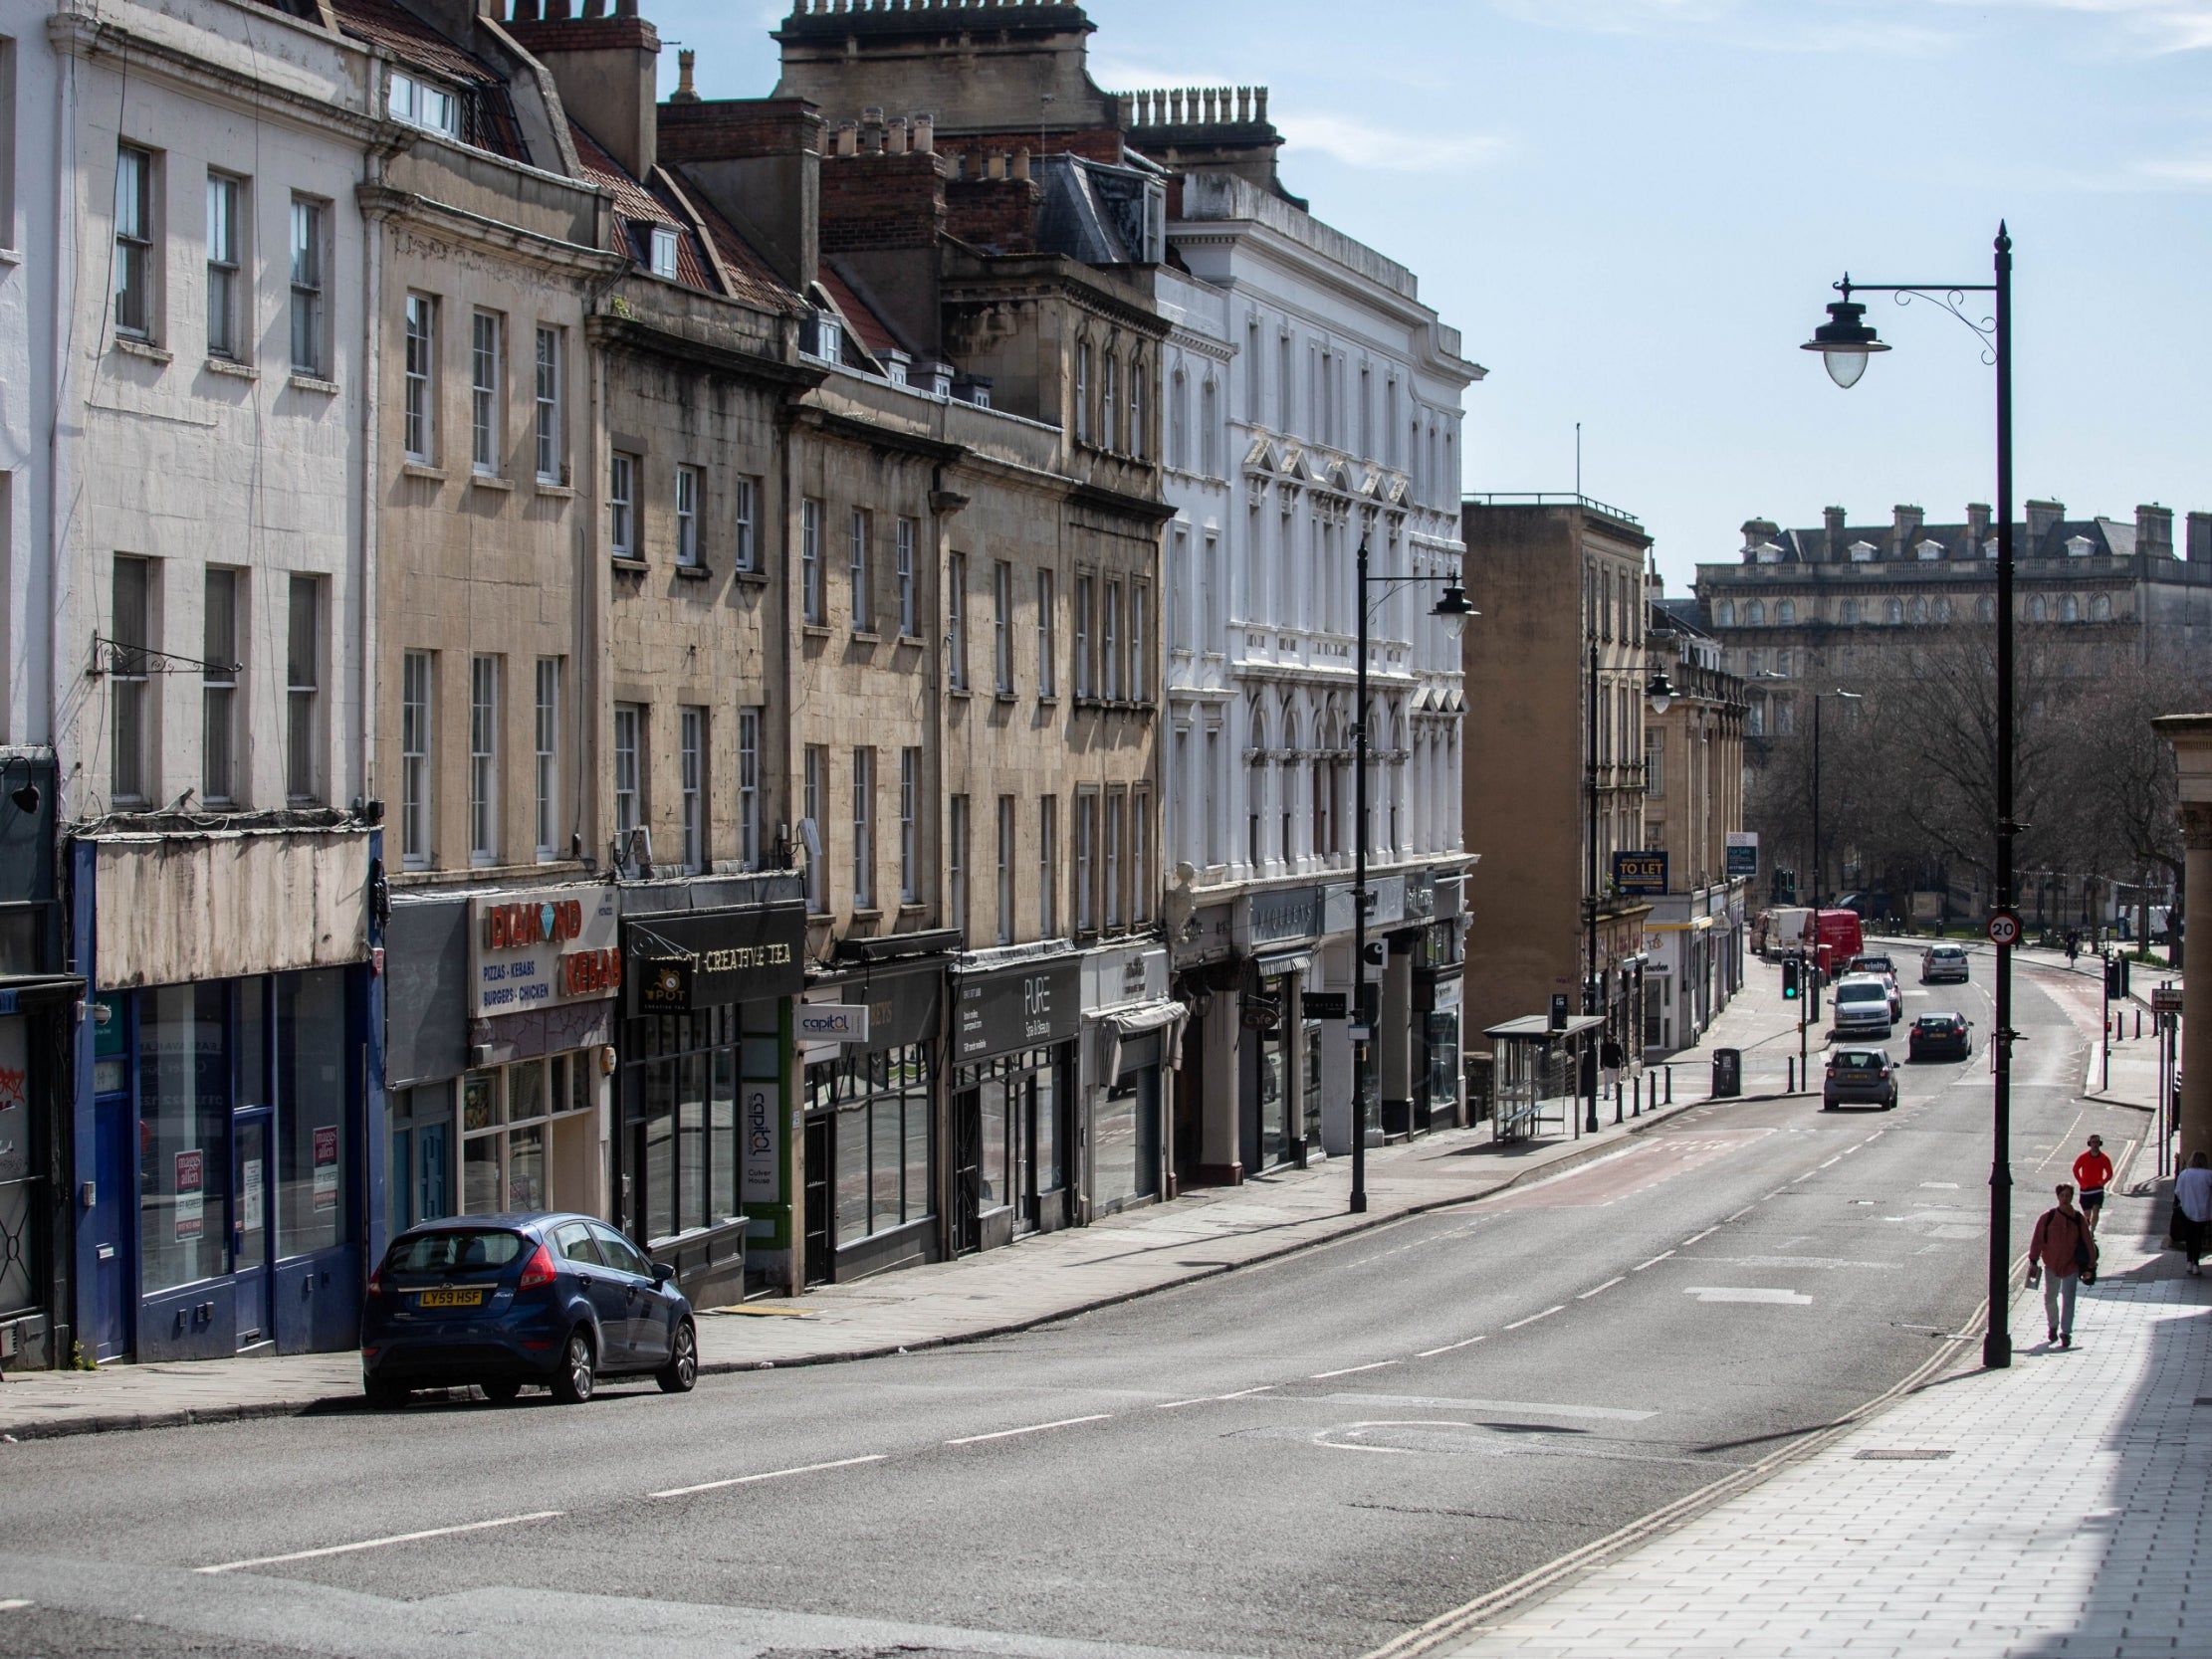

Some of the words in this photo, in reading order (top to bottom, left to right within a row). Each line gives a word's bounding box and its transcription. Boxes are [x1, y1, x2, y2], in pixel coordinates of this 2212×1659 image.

[1620, 863, 1638, 875] TO
[1642, 863, 1663, 875] LET
[1993, 923, 2014, 936] 20
[767, 942, 791, 965] TEA
[483, 963, 506, 981] PIZZAS
[511, 960, 535, 977] KEBABS
[562, 947, 621, 997] KEBAB
[1864, 962, 1887, 972] trinity
[483, 986, 515, 1007] BURGERS
[519, 982, 550, 1002] CHICKEN
[1025, 975, 1051, 1016] PURE
[802, 1014, 849, 1032] capitol
[749, 1093, 772, 1155] capitol
[316, 1130, 336, 1145] maggs
[178, 1155, 201, 1170] maggs
[181, 1168, 199, 1184] allen
[422, 1293, 453, 1305] LY59
[456, 1292, 480, 1304] HSF
